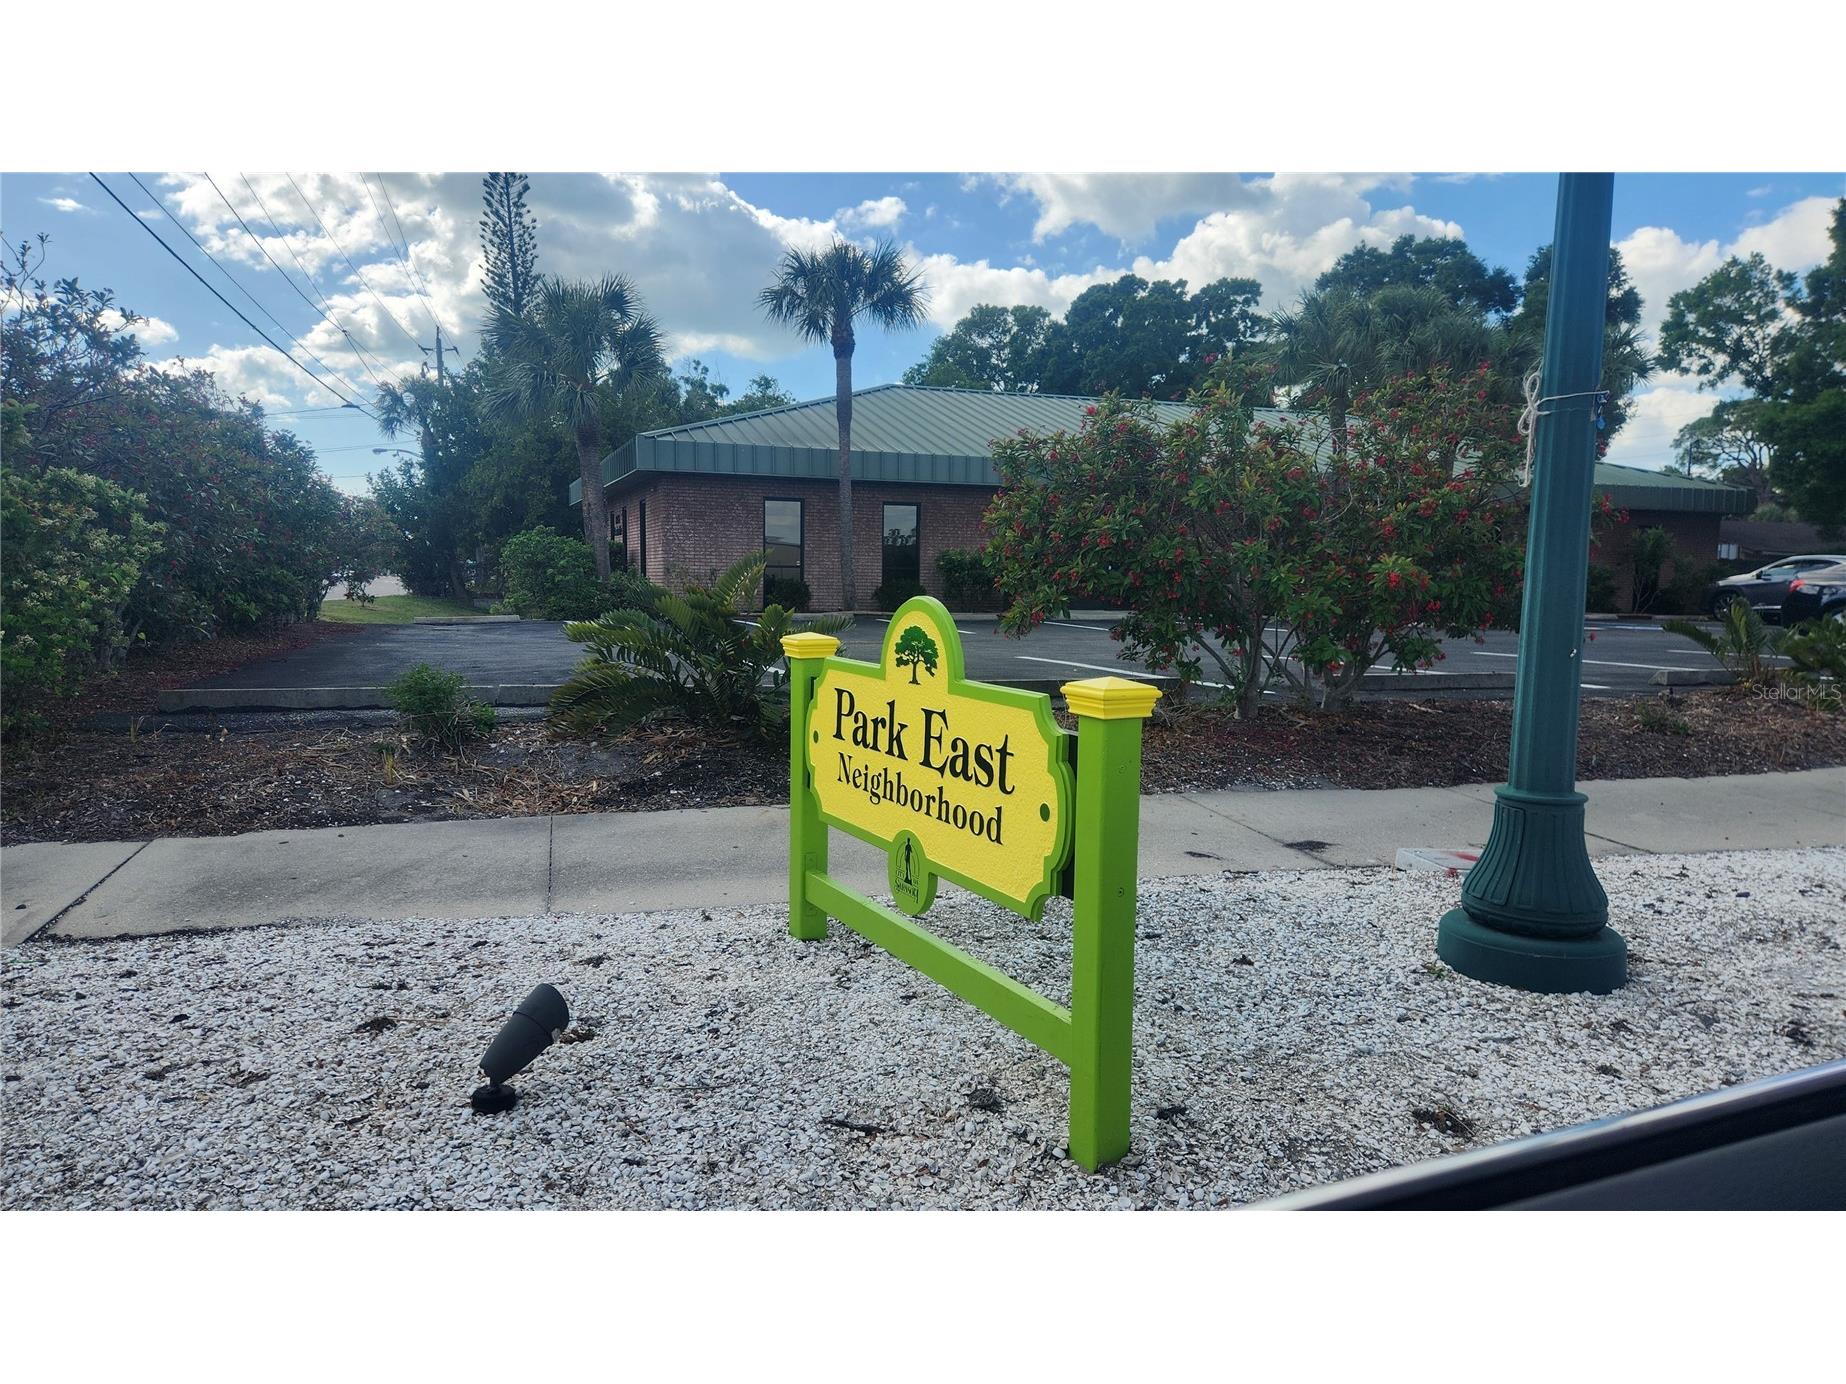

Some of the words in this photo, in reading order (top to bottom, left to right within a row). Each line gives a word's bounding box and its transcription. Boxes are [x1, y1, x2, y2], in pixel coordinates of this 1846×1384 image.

[832, 687, 909, 761] Park
[919, 707, 1016, 796] East
[837, 751, 1004, 846] Neighborhood
